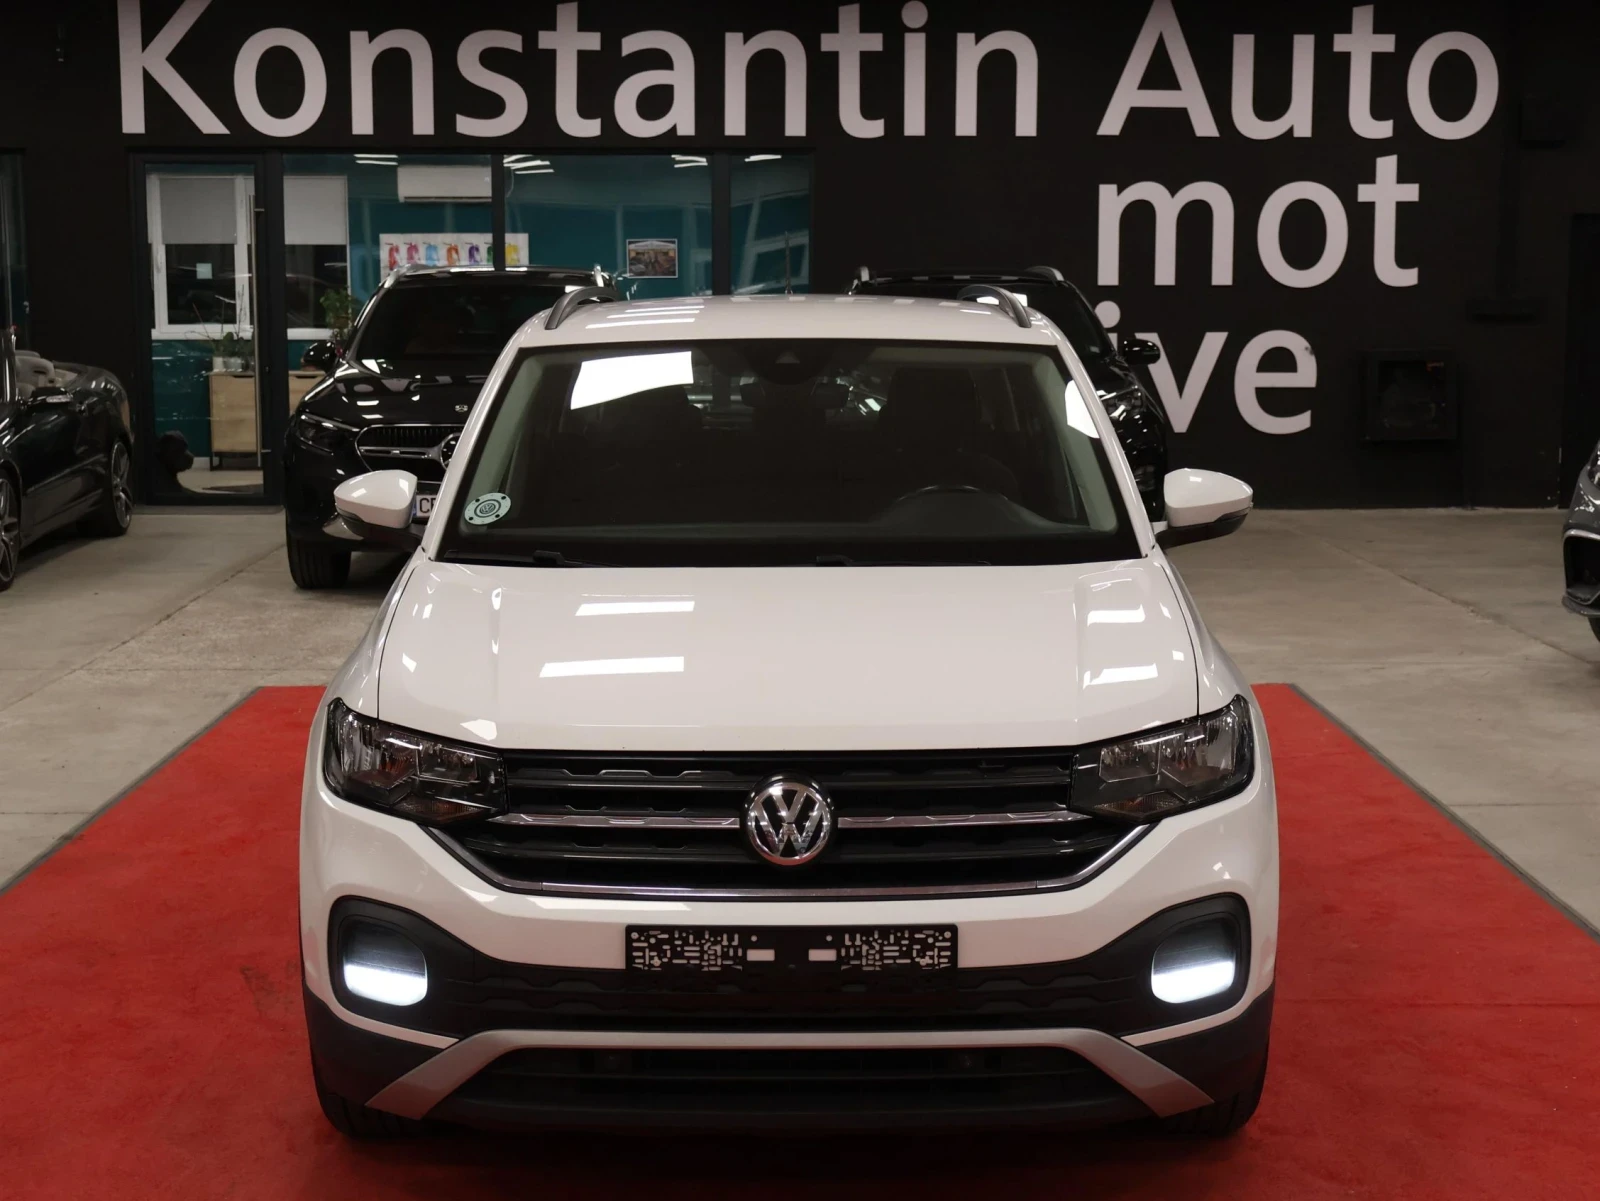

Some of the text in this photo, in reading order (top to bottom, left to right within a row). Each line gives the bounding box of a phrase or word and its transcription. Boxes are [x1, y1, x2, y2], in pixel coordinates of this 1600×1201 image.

[117, 0, 1499, 140] Konstantin Auto
[1096, 154, 1420, 288] mot
